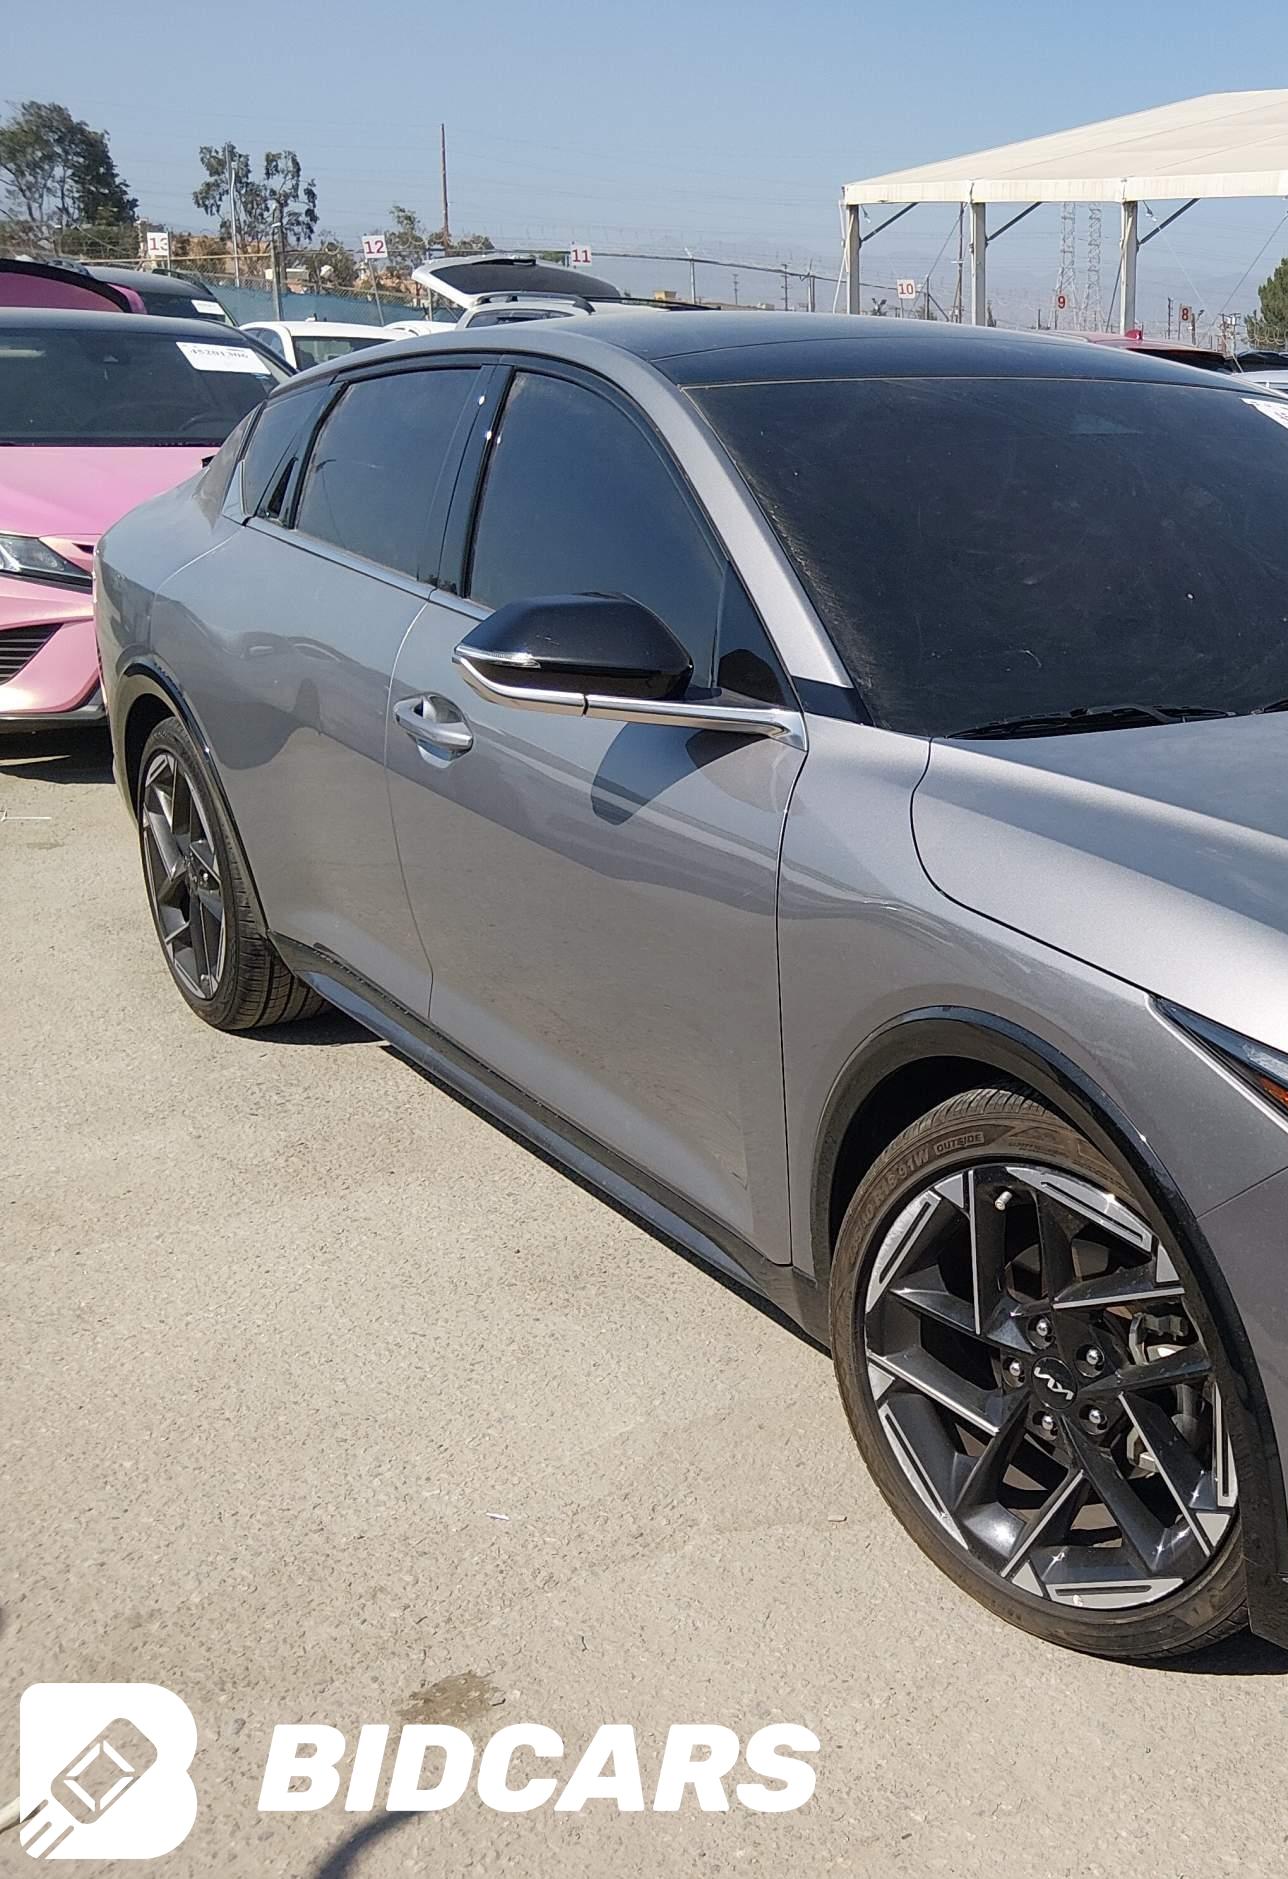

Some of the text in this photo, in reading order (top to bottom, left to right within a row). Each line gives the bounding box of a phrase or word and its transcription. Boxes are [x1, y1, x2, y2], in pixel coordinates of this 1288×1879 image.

[150, 237, 168, 251] 13
[364, 240, 385, 254] 12
[572, 249, 591, 263] 11
[899, 283, 914, 294] 10
[1058, 295, 1065, 309] 9
[1182, 308, 1189, 321] 8
[936, 1134, 983, 1153] OUTSIDE
